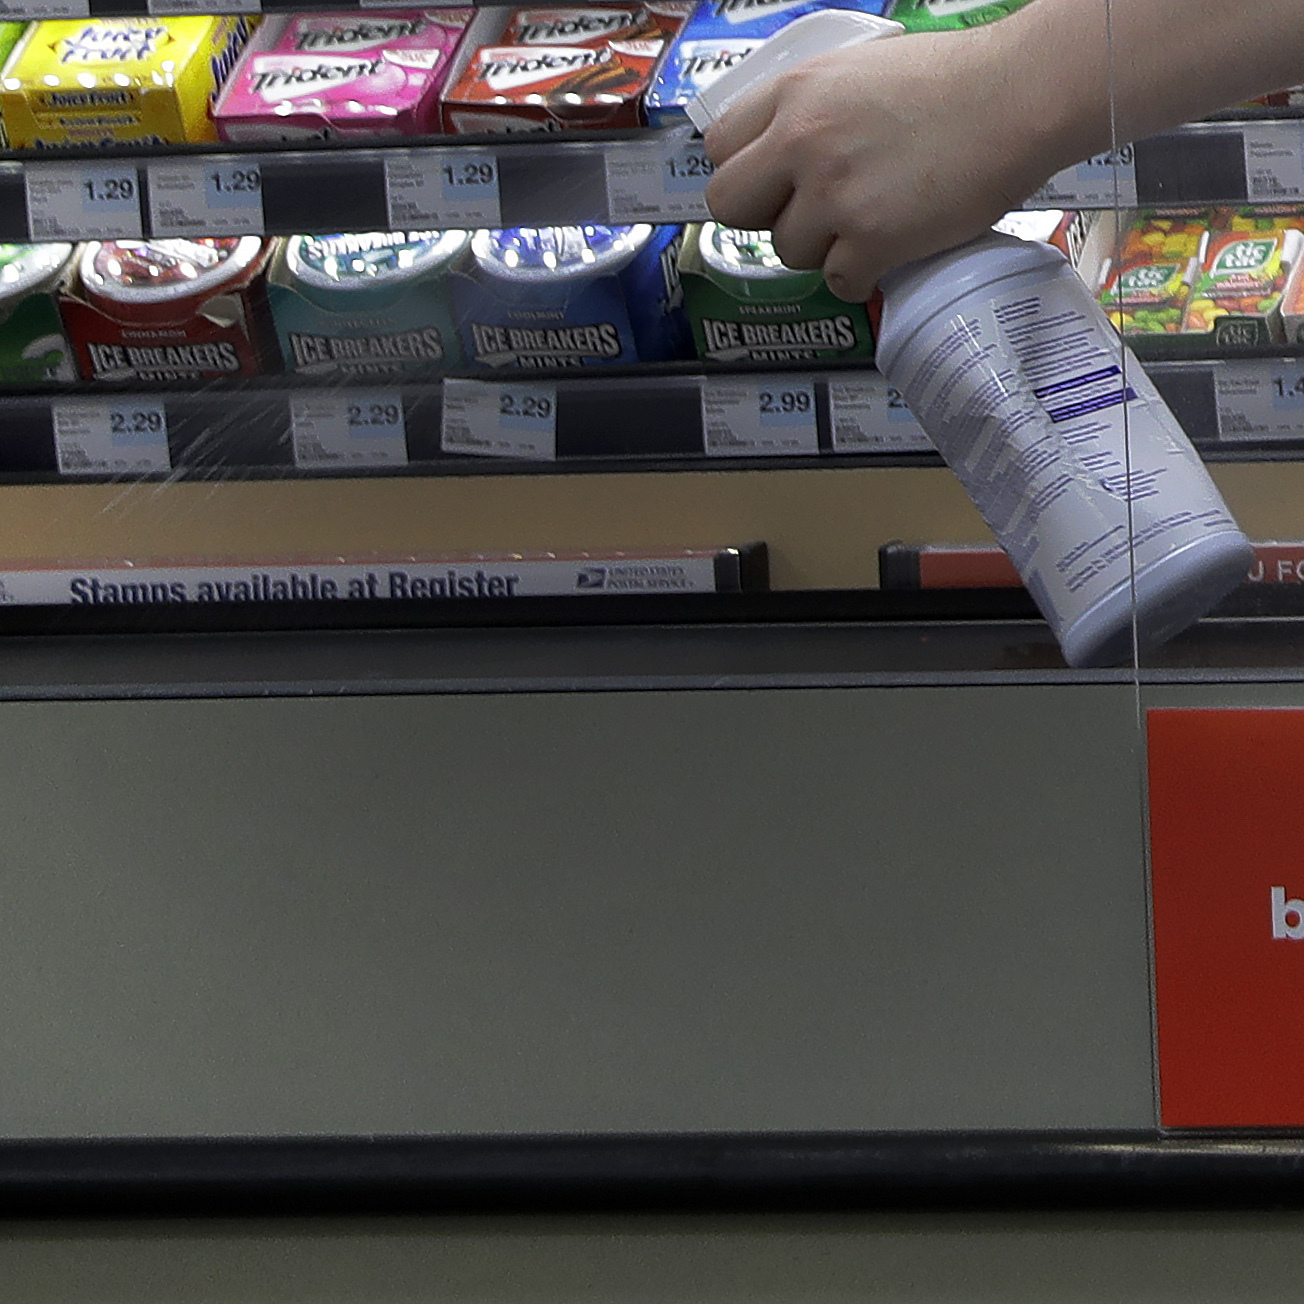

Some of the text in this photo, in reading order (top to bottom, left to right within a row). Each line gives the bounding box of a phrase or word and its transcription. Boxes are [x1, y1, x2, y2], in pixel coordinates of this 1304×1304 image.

[249, 56, 388, 94] Trident
[476, 45, 617, 83] Trident
[680, 50, 750, 81] Trid
[442, 164, 494, 186] 1.29
[662, 155, 714, 177] 1.29
[82, 179, 136, 202] 1.29
[212, 171, 261, 193] 1.29
[290, 326, 444, 366] ICE BREAKERS
[471, 321, 623, 358] ICE BREAKERS
[703, 315, 856, 353] ICE BREAKERS
[88, 340, 241, 373] ICE BREAKERS
[347, 404, 400, 426] 2.29
[499, 396, 551, 419] 2.29
[758, 390, 812, 413] 2.99
[110, 411, 164, 434] 2.29
[69, 570, 521, 605] Stamps available at Register
